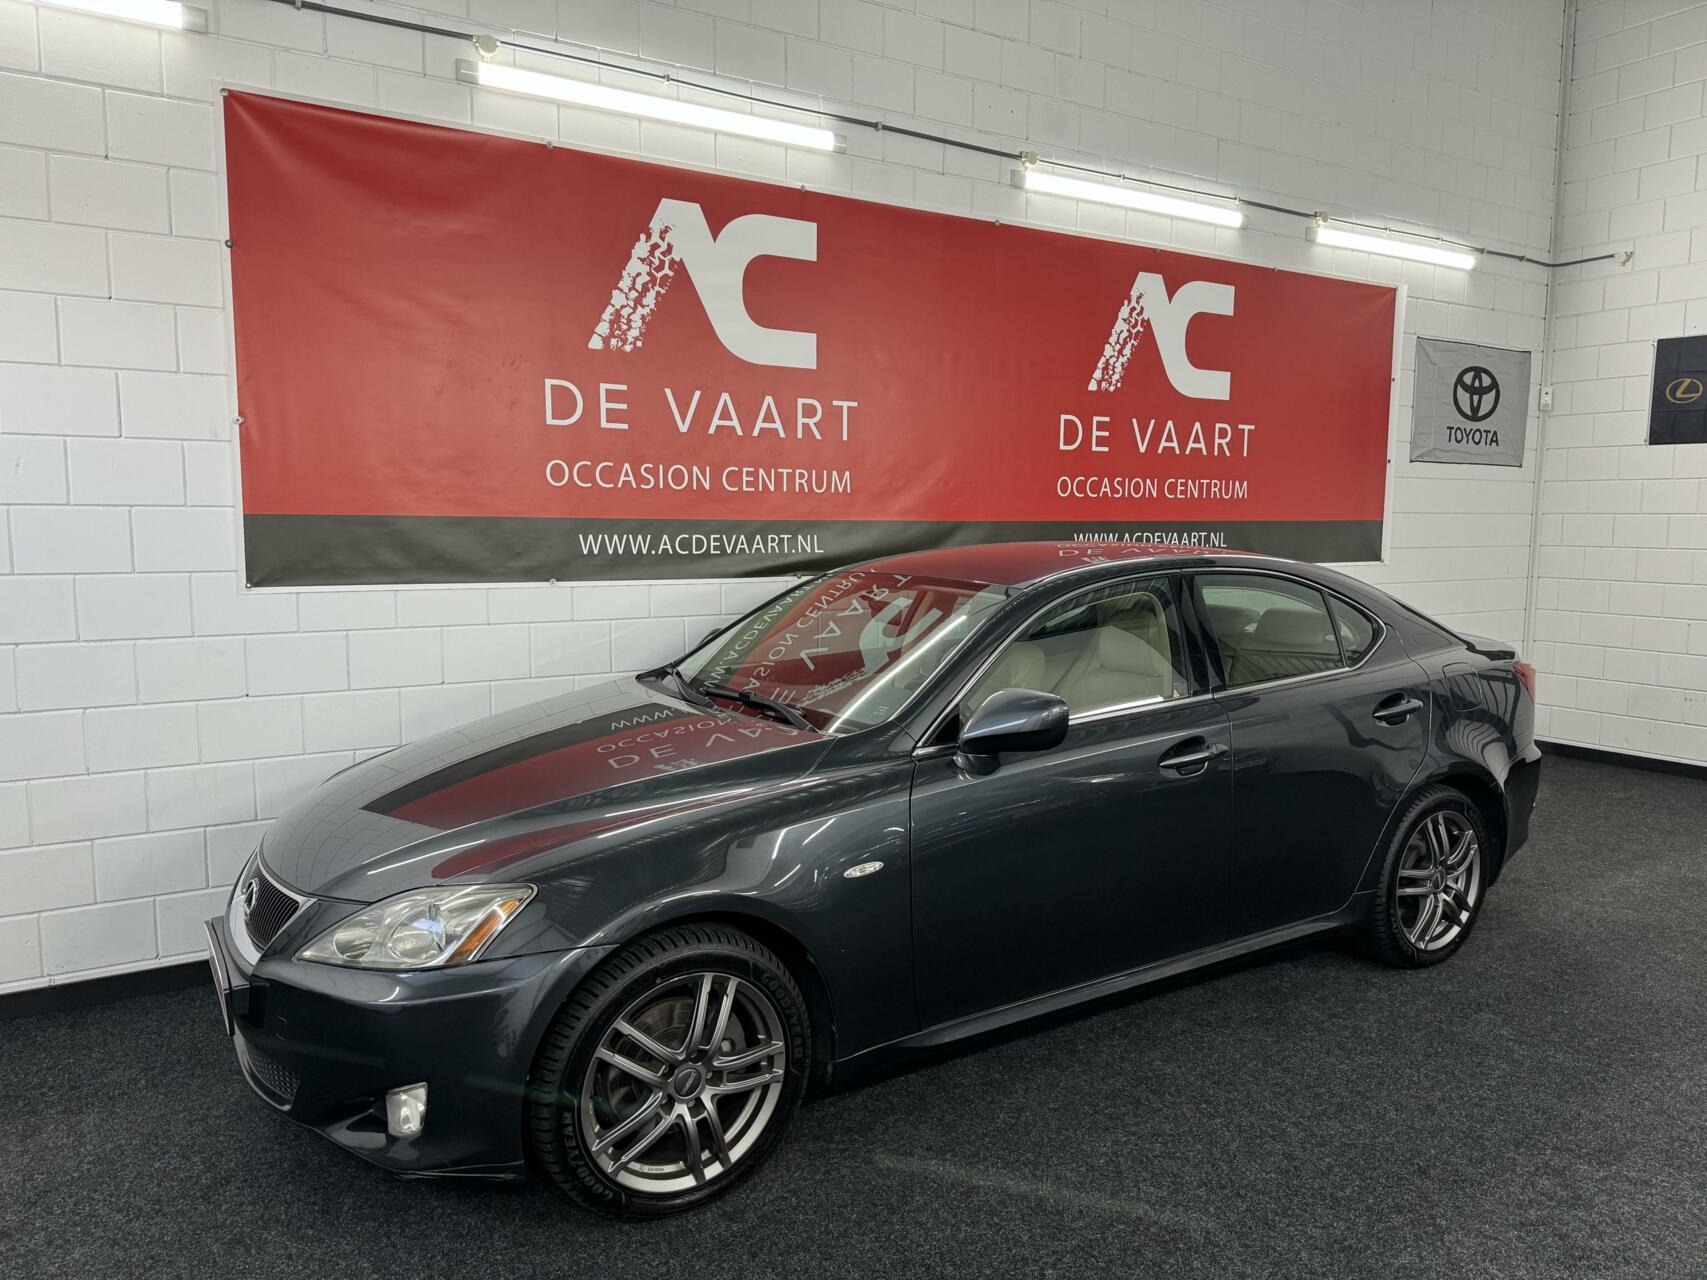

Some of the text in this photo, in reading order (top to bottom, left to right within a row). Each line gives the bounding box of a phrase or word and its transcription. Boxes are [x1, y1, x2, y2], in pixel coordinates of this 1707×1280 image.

[587, 198, 818, 370] AC
[1087, 271, 1236, 401] AC
[544, 378, 858, 441] DE VAART
[1058, 414, 1256, 457] DE VAART
[1446, 426, 1500, 447] TOYOTA
[545, 459, 852, 493] OCCASION CENTRUM
[1056, 476, 1249, 500] OCCASION CENTRUM
[578, 533, 825, 555] WWW.ACDEVAART.NL
[1073, 532, 1228, 548] WWWACDEVAART.NL
